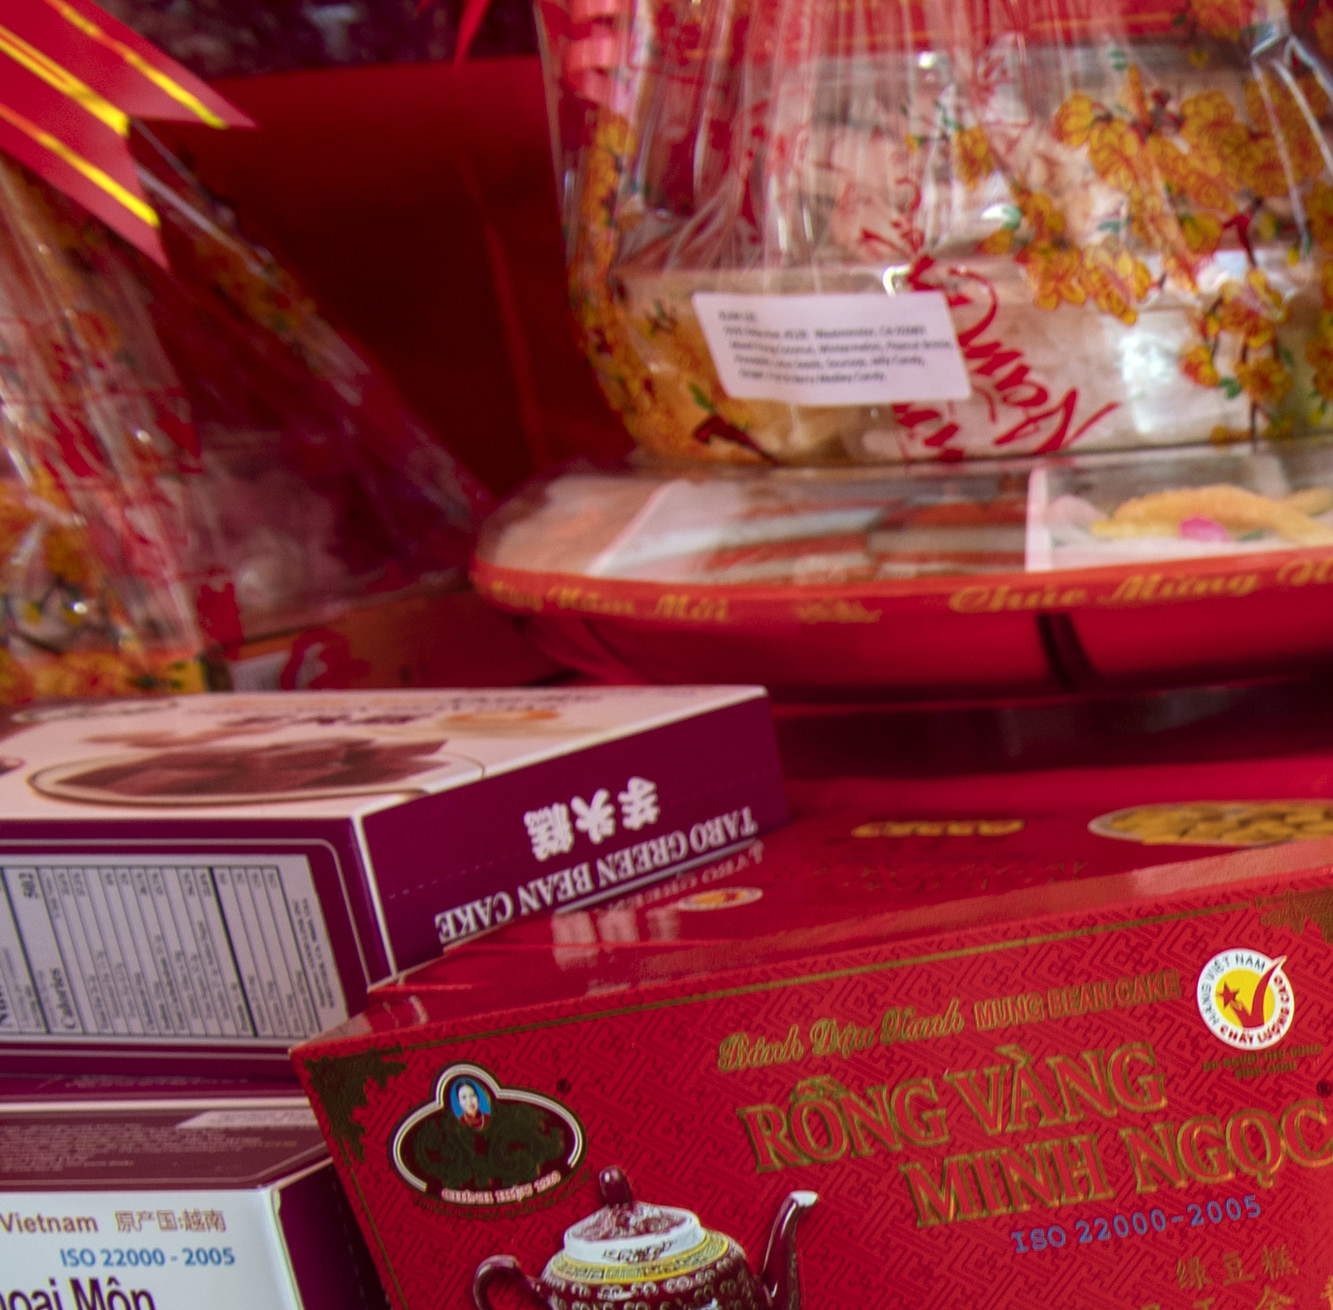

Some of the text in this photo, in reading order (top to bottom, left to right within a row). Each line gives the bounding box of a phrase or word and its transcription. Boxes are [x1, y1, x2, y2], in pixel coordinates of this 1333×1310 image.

[690, 806, 758, 852] TARO
[597, 830, 689, 887] GREEN
[517, 862, 594, 916] BEAN
[434, 890, 514, 945] CAKE
[1235, 953, 1266, 972] NAM
[973, 999, 1045, 1030] MUNG
[1046, 985, 1112, 1019] BEAN
[1113, 969, 1182, 1005] CAKE
[737, 1043, 1167, 1173] RỒNG VÀNG
[900, 1135, 1115, 1228] MINH
[0, 1213, 98, 1233] Vietnam
[1011, 1195, 1263, 1254] ISO 22000-2005
[60, 1248, 95, 1266] ISO
[102, 1248, 165, 1266] 22000
[183, 1247, 235, 1266] 2005
